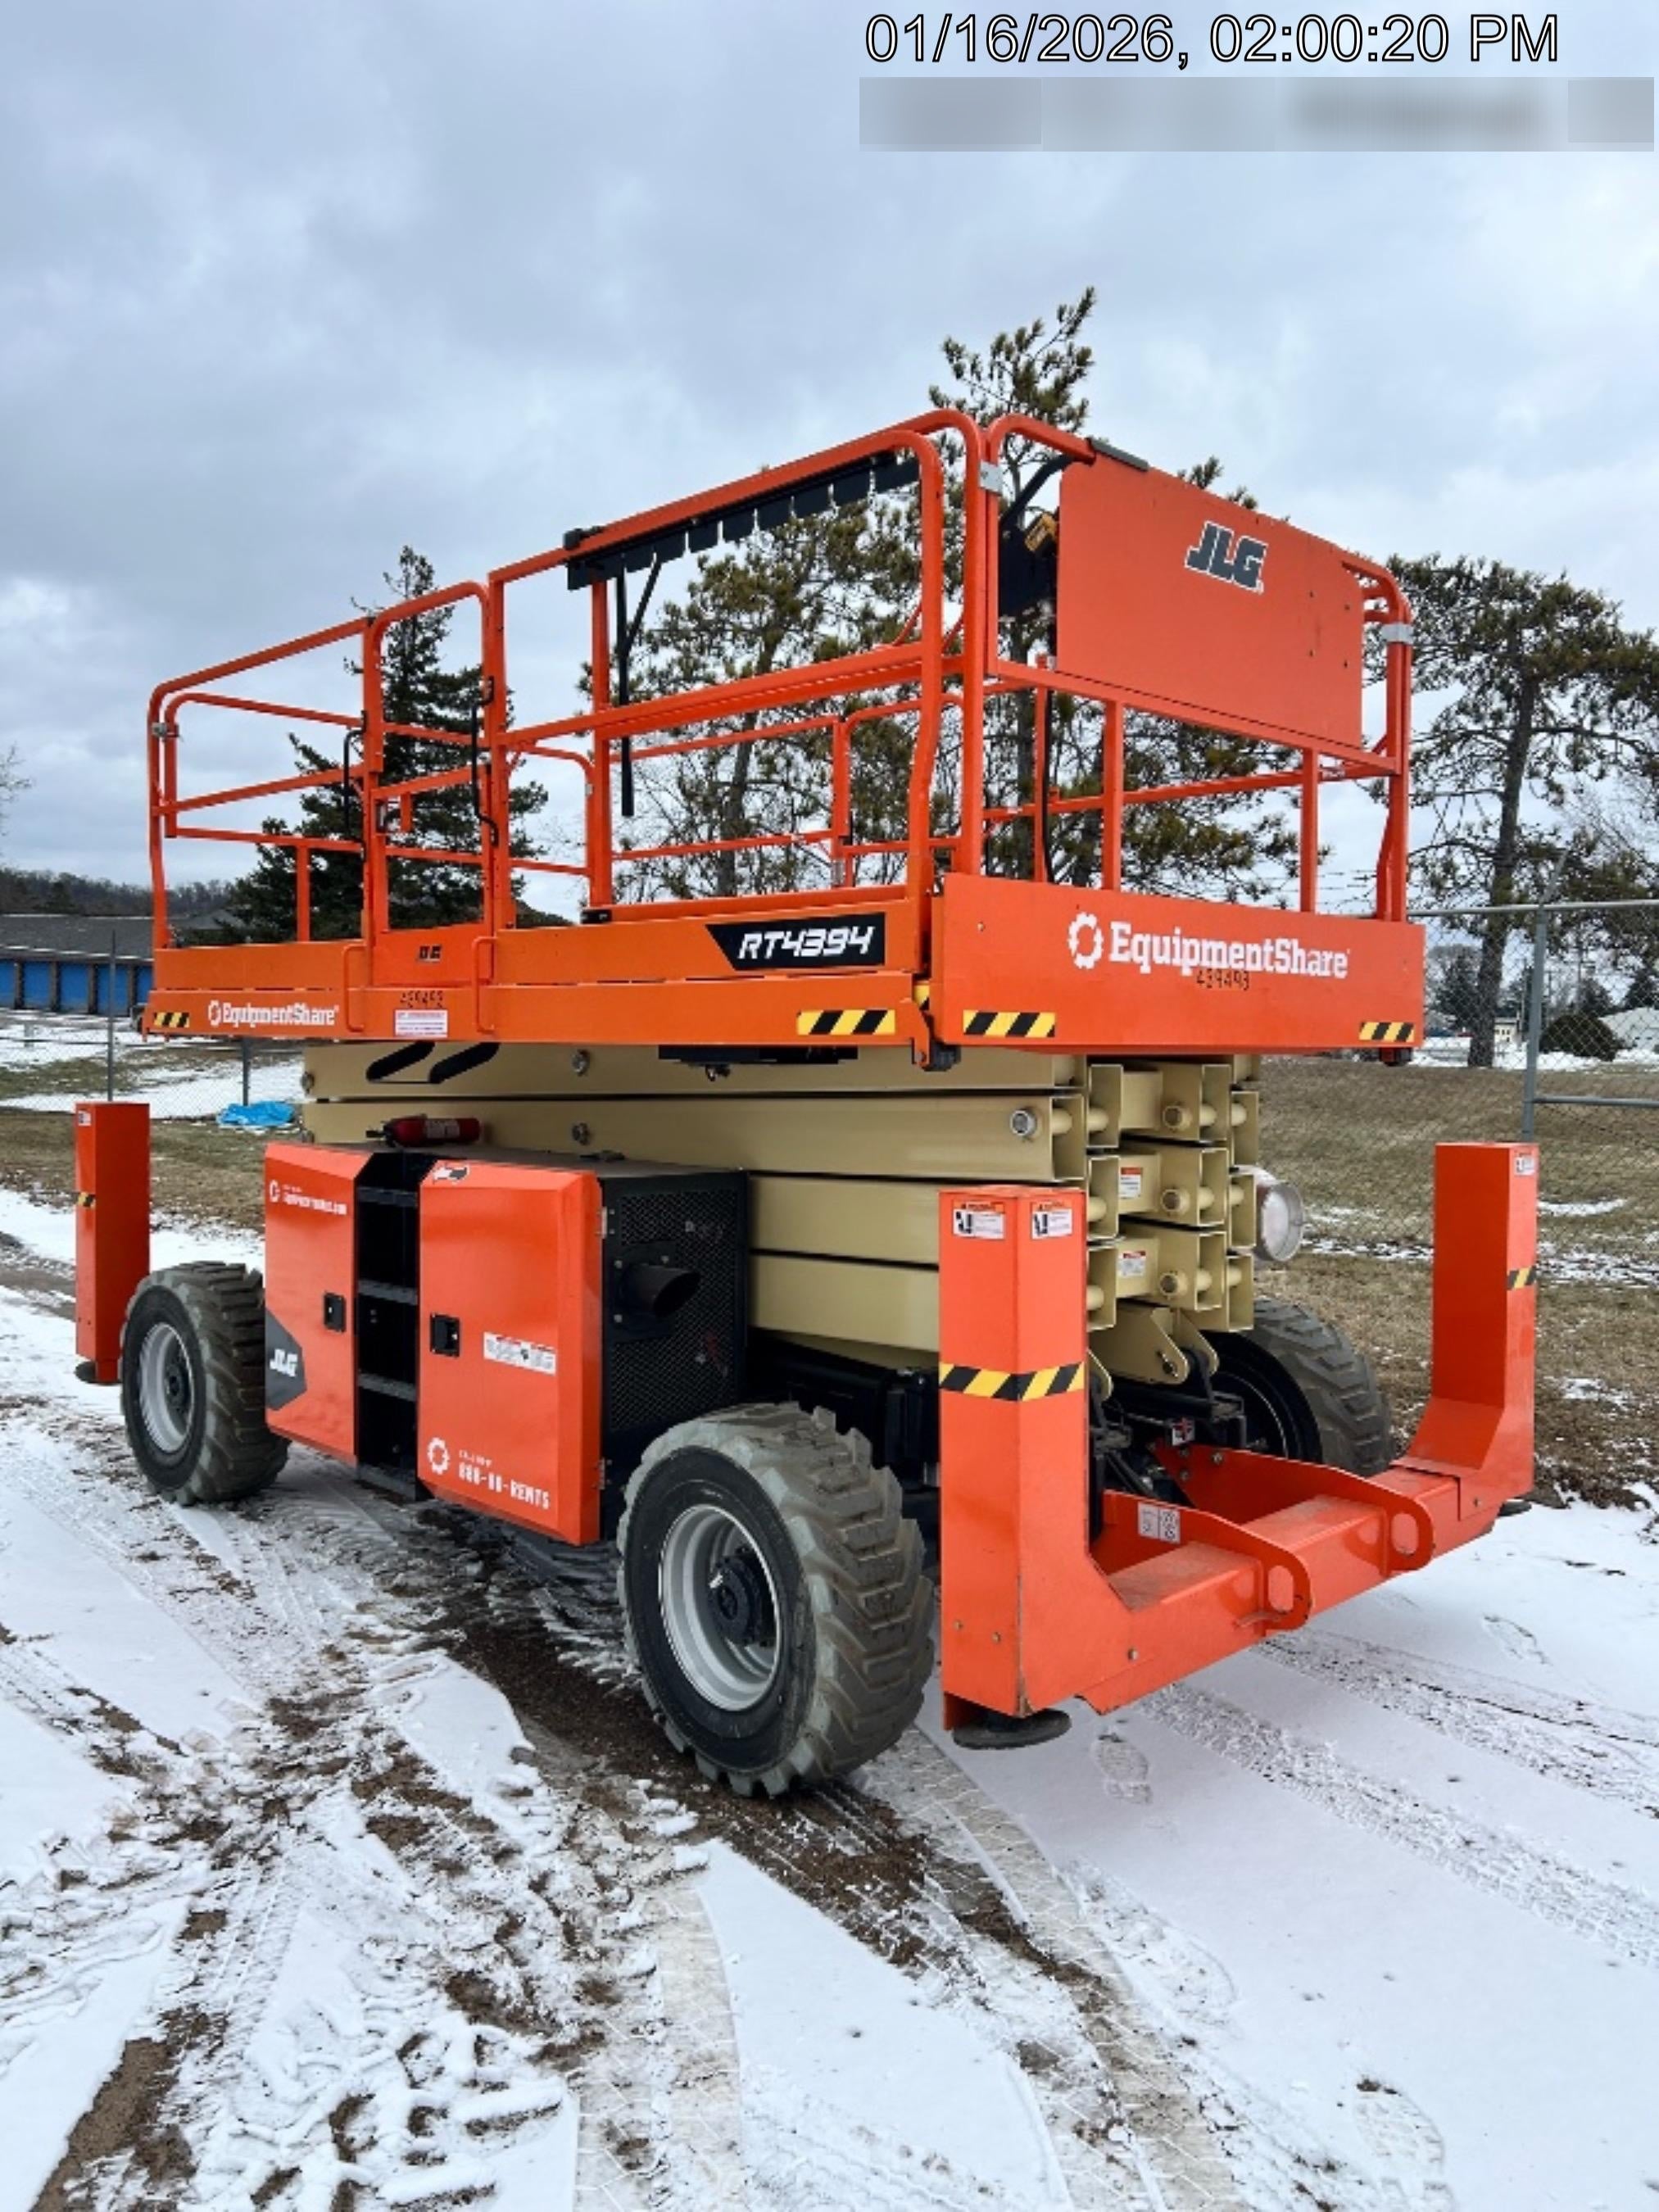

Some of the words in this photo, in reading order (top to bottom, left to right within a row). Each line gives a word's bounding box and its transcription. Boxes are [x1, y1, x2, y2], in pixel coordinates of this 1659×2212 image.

[1184, 520, 1268, 594] JLG
[738, 926, 875, 959] RT4394
[1109, 921, 1348, 979] EquipmentShare
[223, 1002, 335, 1028] EquipmentShare
[270, 1349, 298, 1377] JLG
